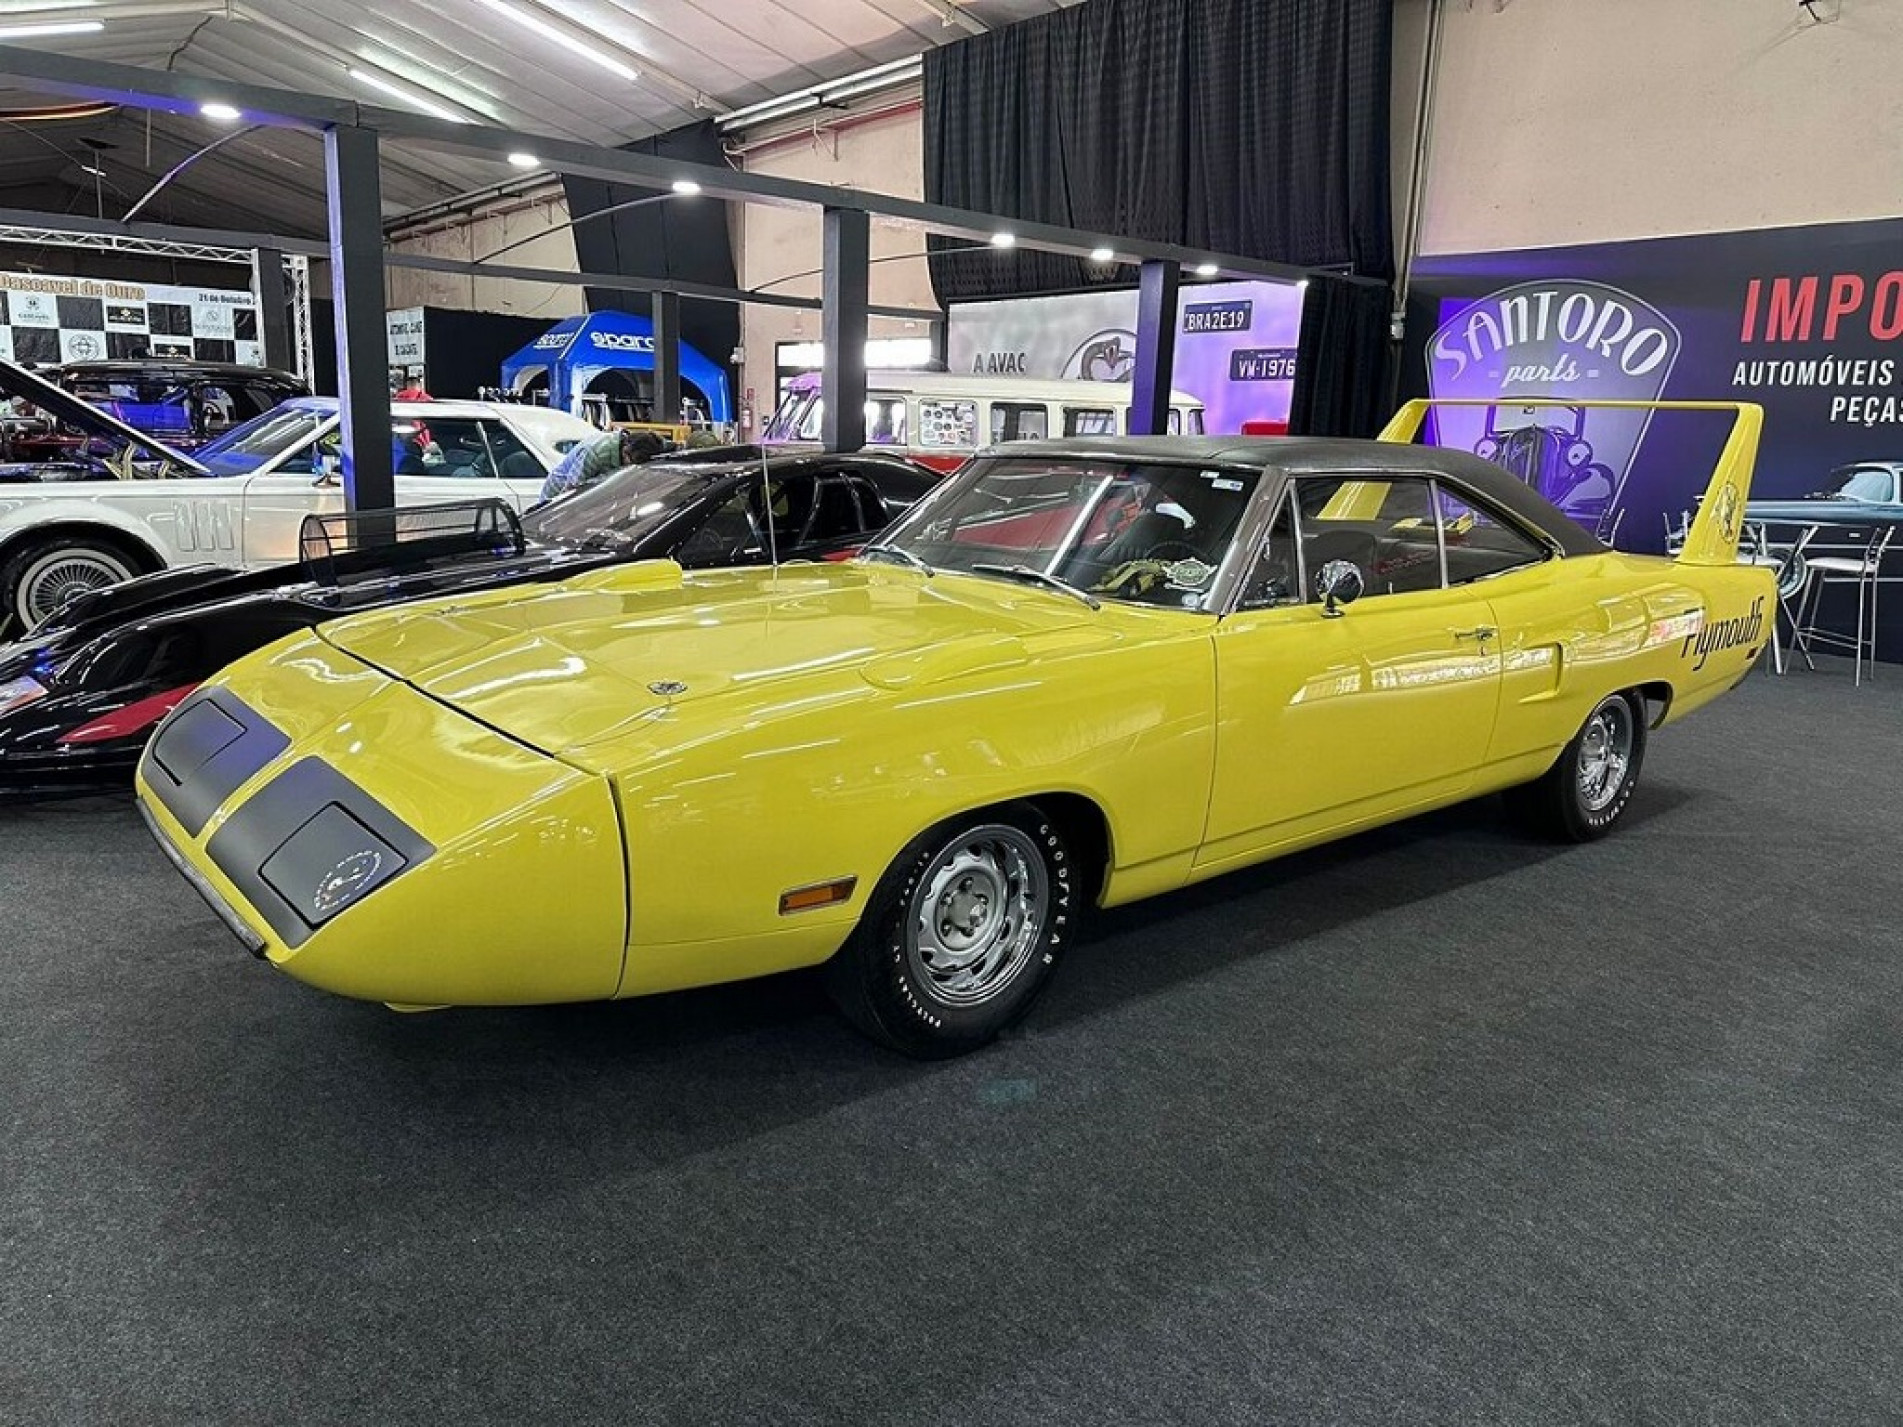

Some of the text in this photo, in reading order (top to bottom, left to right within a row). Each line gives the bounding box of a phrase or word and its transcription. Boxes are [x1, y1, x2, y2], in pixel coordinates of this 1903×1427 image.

[1188, 311, 1244, 330] BRA2E19
[1740, 270, 1903, 343] IMPO
[1435, 291, 1668, 381] SANTORO
[987, 352, 1026, 373] AVAC
[1239, 359, 1296, 378] VW-1976
[1501, 353, 1581, 388] parts
[1732, 354, 1895, 386] AUTOMÓVEIS
[1681, 595, 1765, 671] Plymouth
